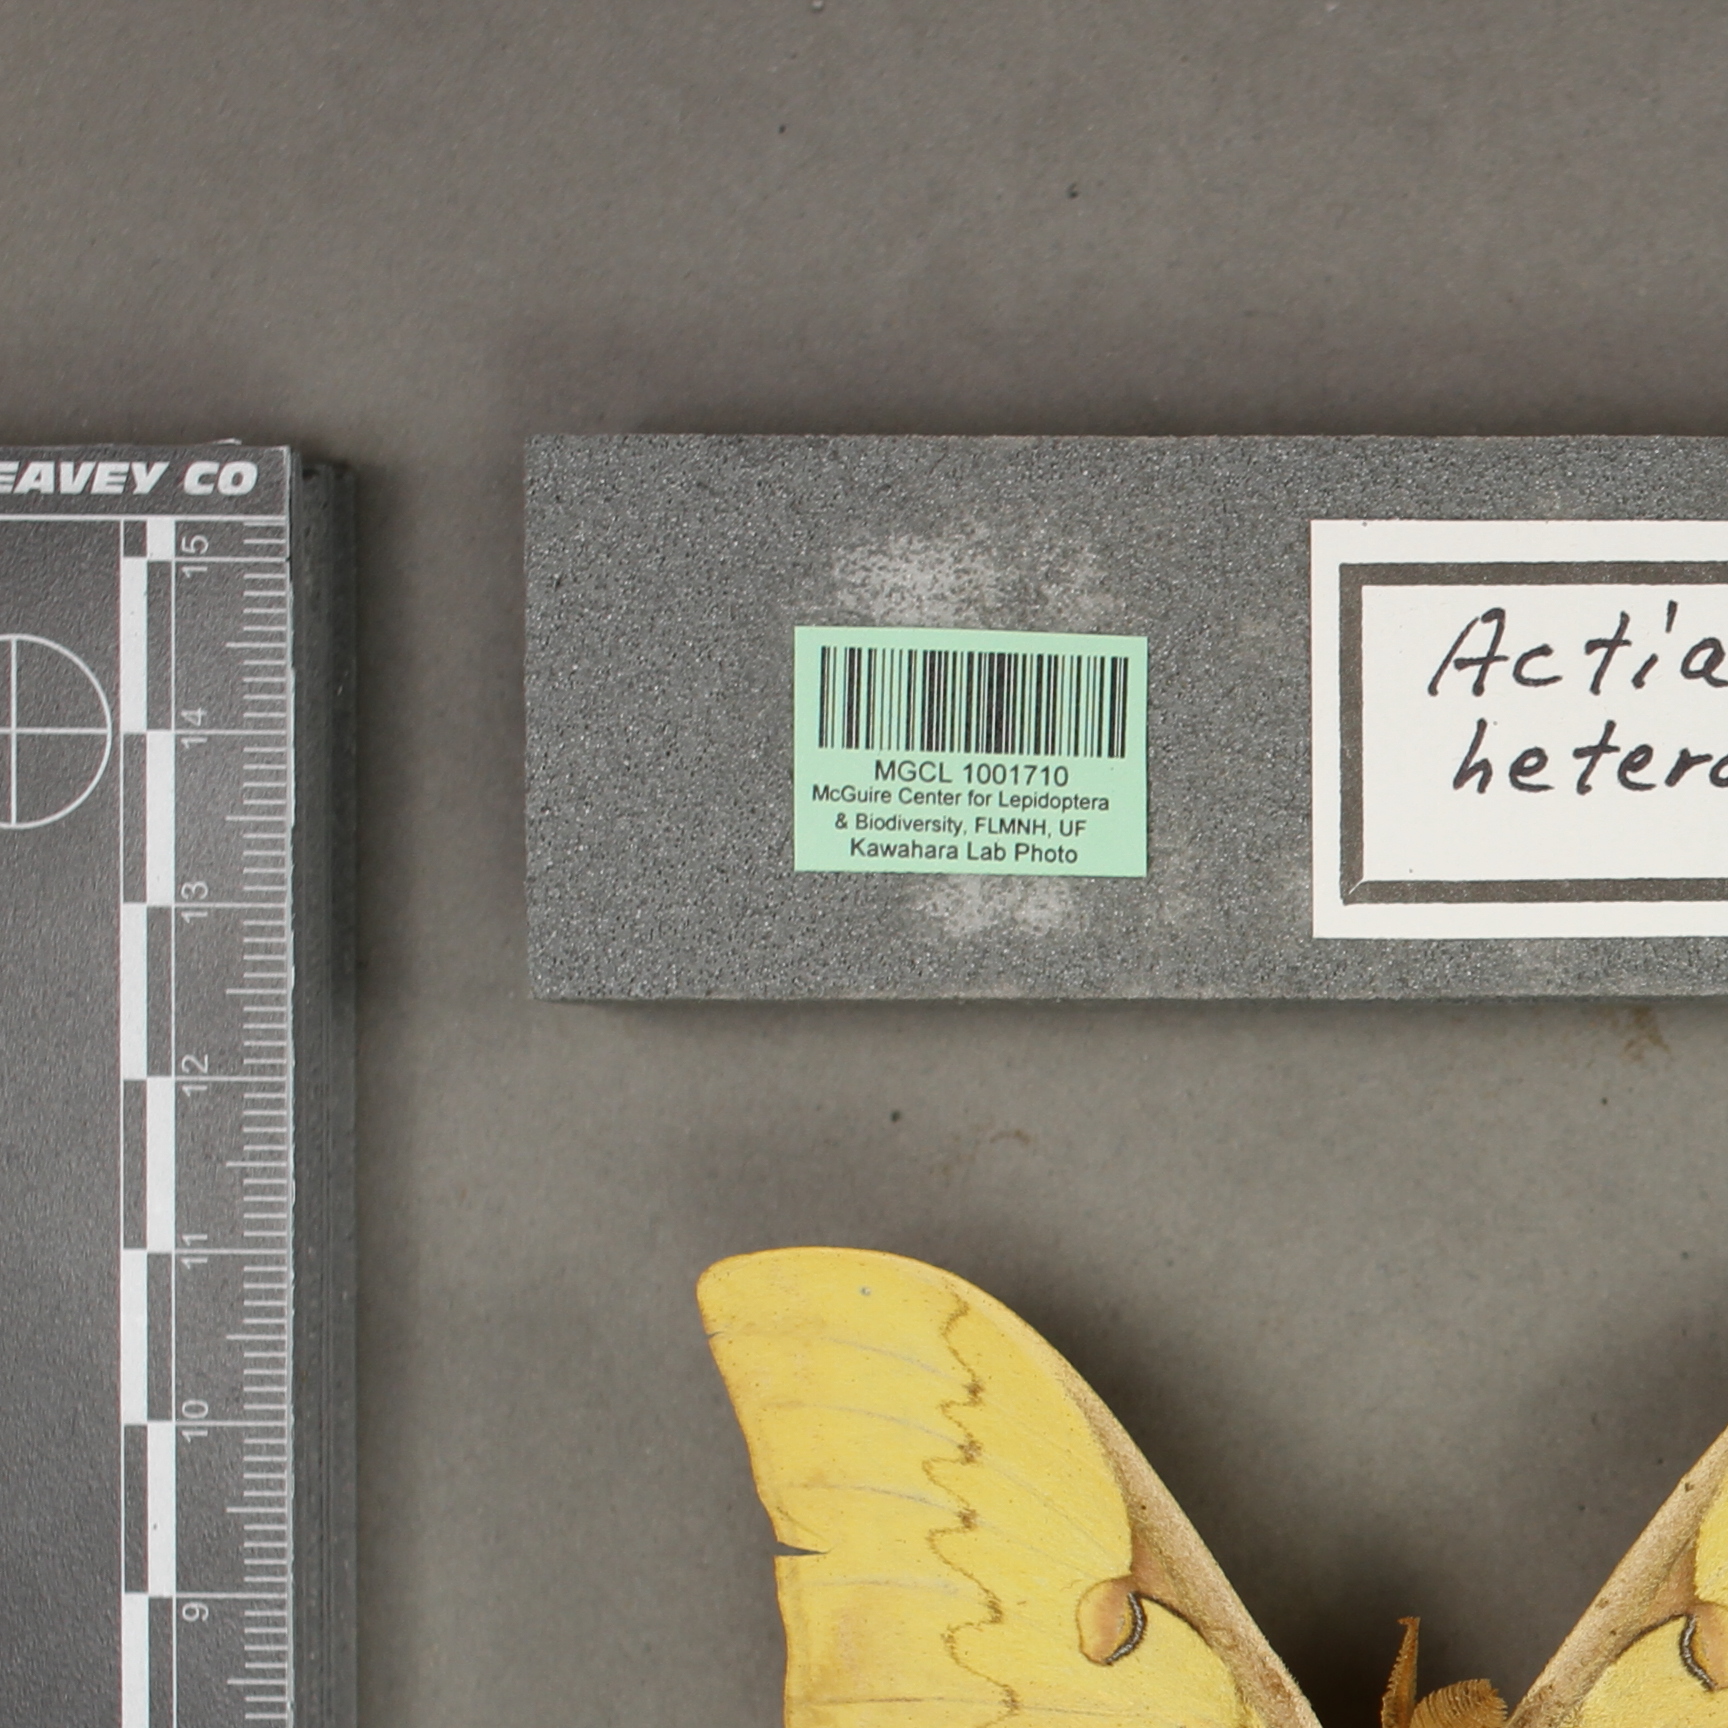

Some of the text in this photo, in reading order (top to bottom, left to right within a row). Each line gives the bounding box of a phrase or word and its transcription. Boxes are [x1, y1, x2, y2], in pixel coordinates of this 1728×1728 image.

[183, 461, 258, 495] CO
[181, 534, 208, 577] 15
[181, 707, 208, 749] 14
[873, 759, 1070, 787] MGCL 1001710
[812, 784, 1110, 815] McGuire Center for Lepidoptera
[834, 812, 1087, 838] & Biodiversity, FLMNH, UF
[850, 837, 1079, 864] Kawahara Lab Photo
[181, 880, 208, 923] 13
[181, 1053, 209, 1098] 12
[182, 1232, 209, 1270] 11
[182, 1400, 209, 1444] 10
[182, 1601, 209, 1622] 9
